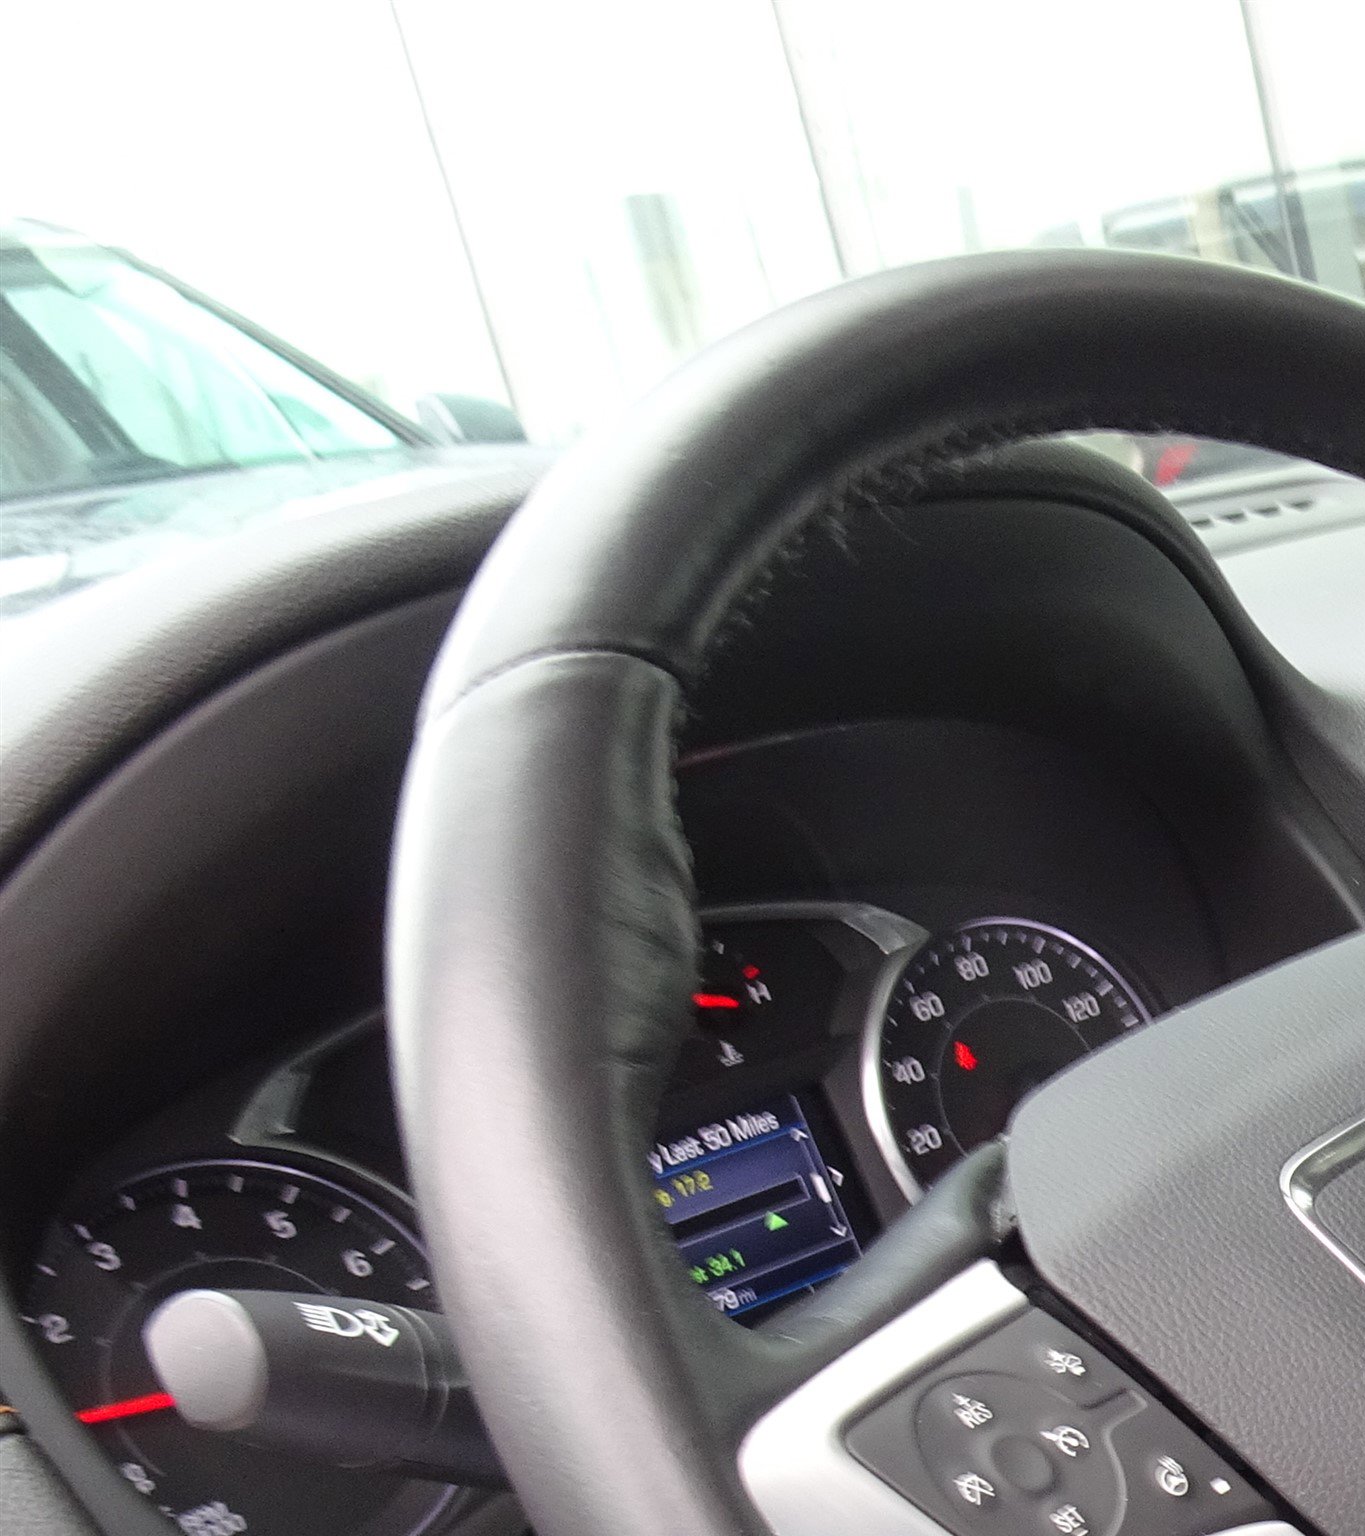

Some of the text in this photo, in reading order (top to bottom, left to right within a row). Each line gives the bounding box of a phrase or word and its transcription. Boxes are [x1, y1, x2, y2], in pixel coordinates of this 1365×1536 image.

[954, 951, 989, 981] 80
[1012, 958, 1053, 990] 100
[909, 990, 945, 1022] 60
[1062, 991, 1100, 1024] 120
[891, 1055, 925, 1084] 40
[657, 1130, 705, 1164] Last
[697, 1121, 732, 1151] 50
[725, 1110, 781, 1143] Miles
[906, 1123, 943, 1155] 20
[171, 1202, 202, 1231] 4
[263, 1209, 298, 1239] 5
[87, 1241, 122, 1272] 3
[341, 1249, 374, 1278] 6
[705, 1247, 748, 1279] 34.1
[37, 1312, 75, 1345] 2
[953, 1399, 994, 1430] RES
[1049, 1503, 1086, 1534] SET
